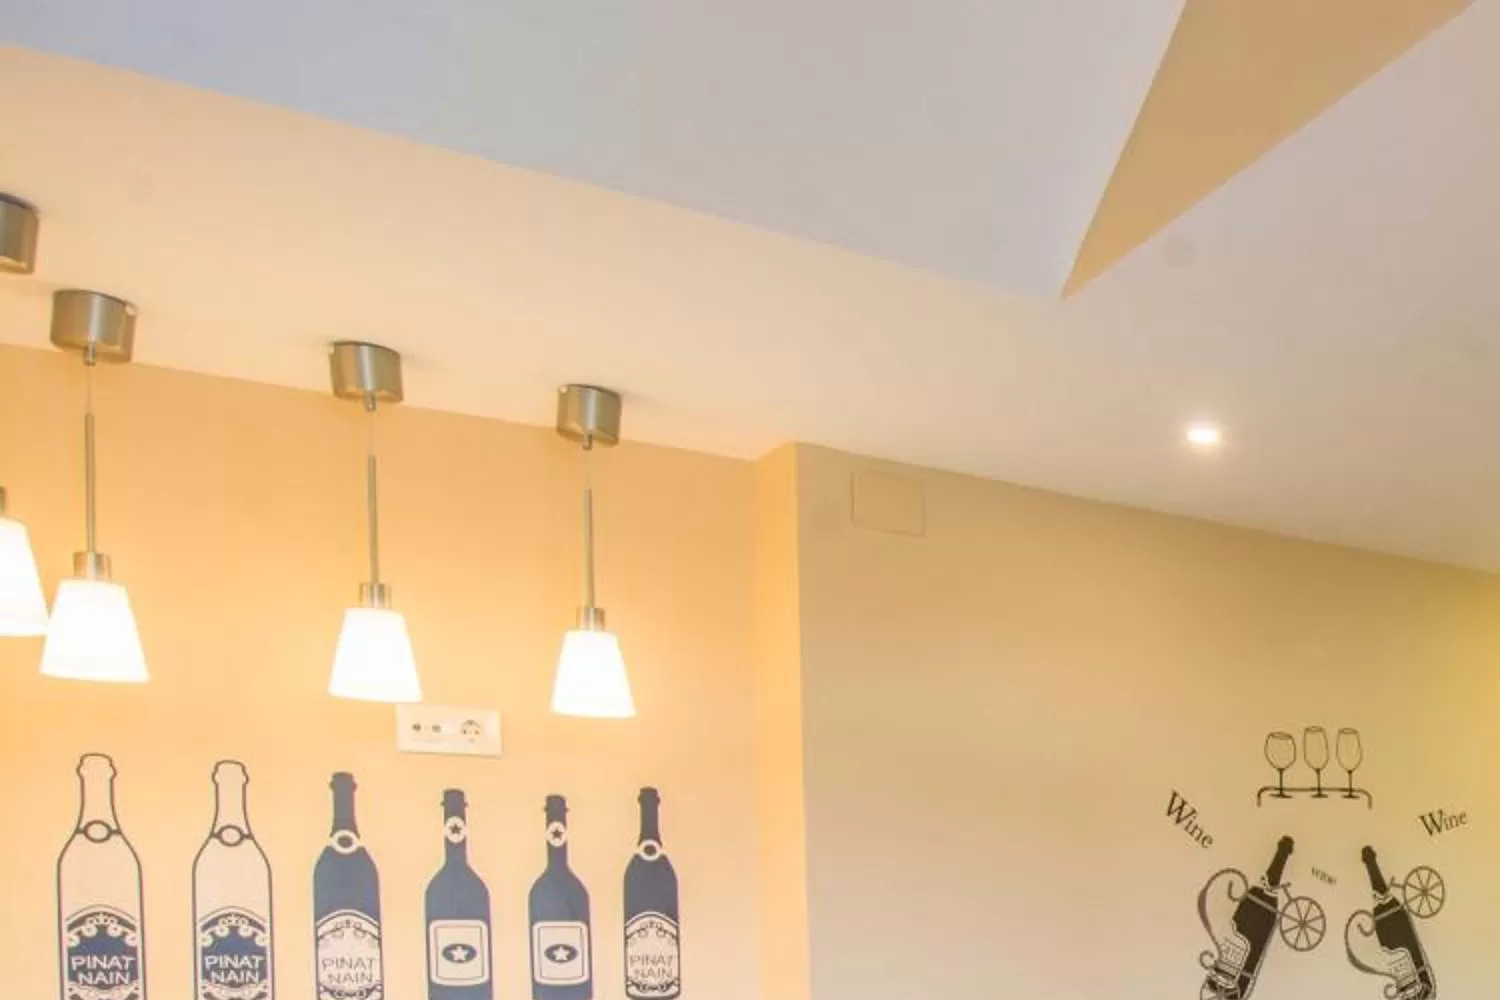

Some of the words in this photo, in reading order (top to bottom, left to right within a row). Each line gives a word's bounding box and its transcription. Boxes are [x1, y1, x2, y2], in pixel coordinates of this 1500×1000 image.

[1164, 789, 1214, 850] Wine
[1417, 808, 1470, 838] Wine
[71, 954, 136, 971] PINAT
[203, 954, 265, 970] PINAT
[321, 957, 377, 971] PINAT
[628, 954, 675, 967] PINAT
[77, 971, 131, 985] NAIN
[210, 970, 260, 984] NAIN
[327, 970, 374, 984] NAIN
[633, 966, 674, 979] NAIN
